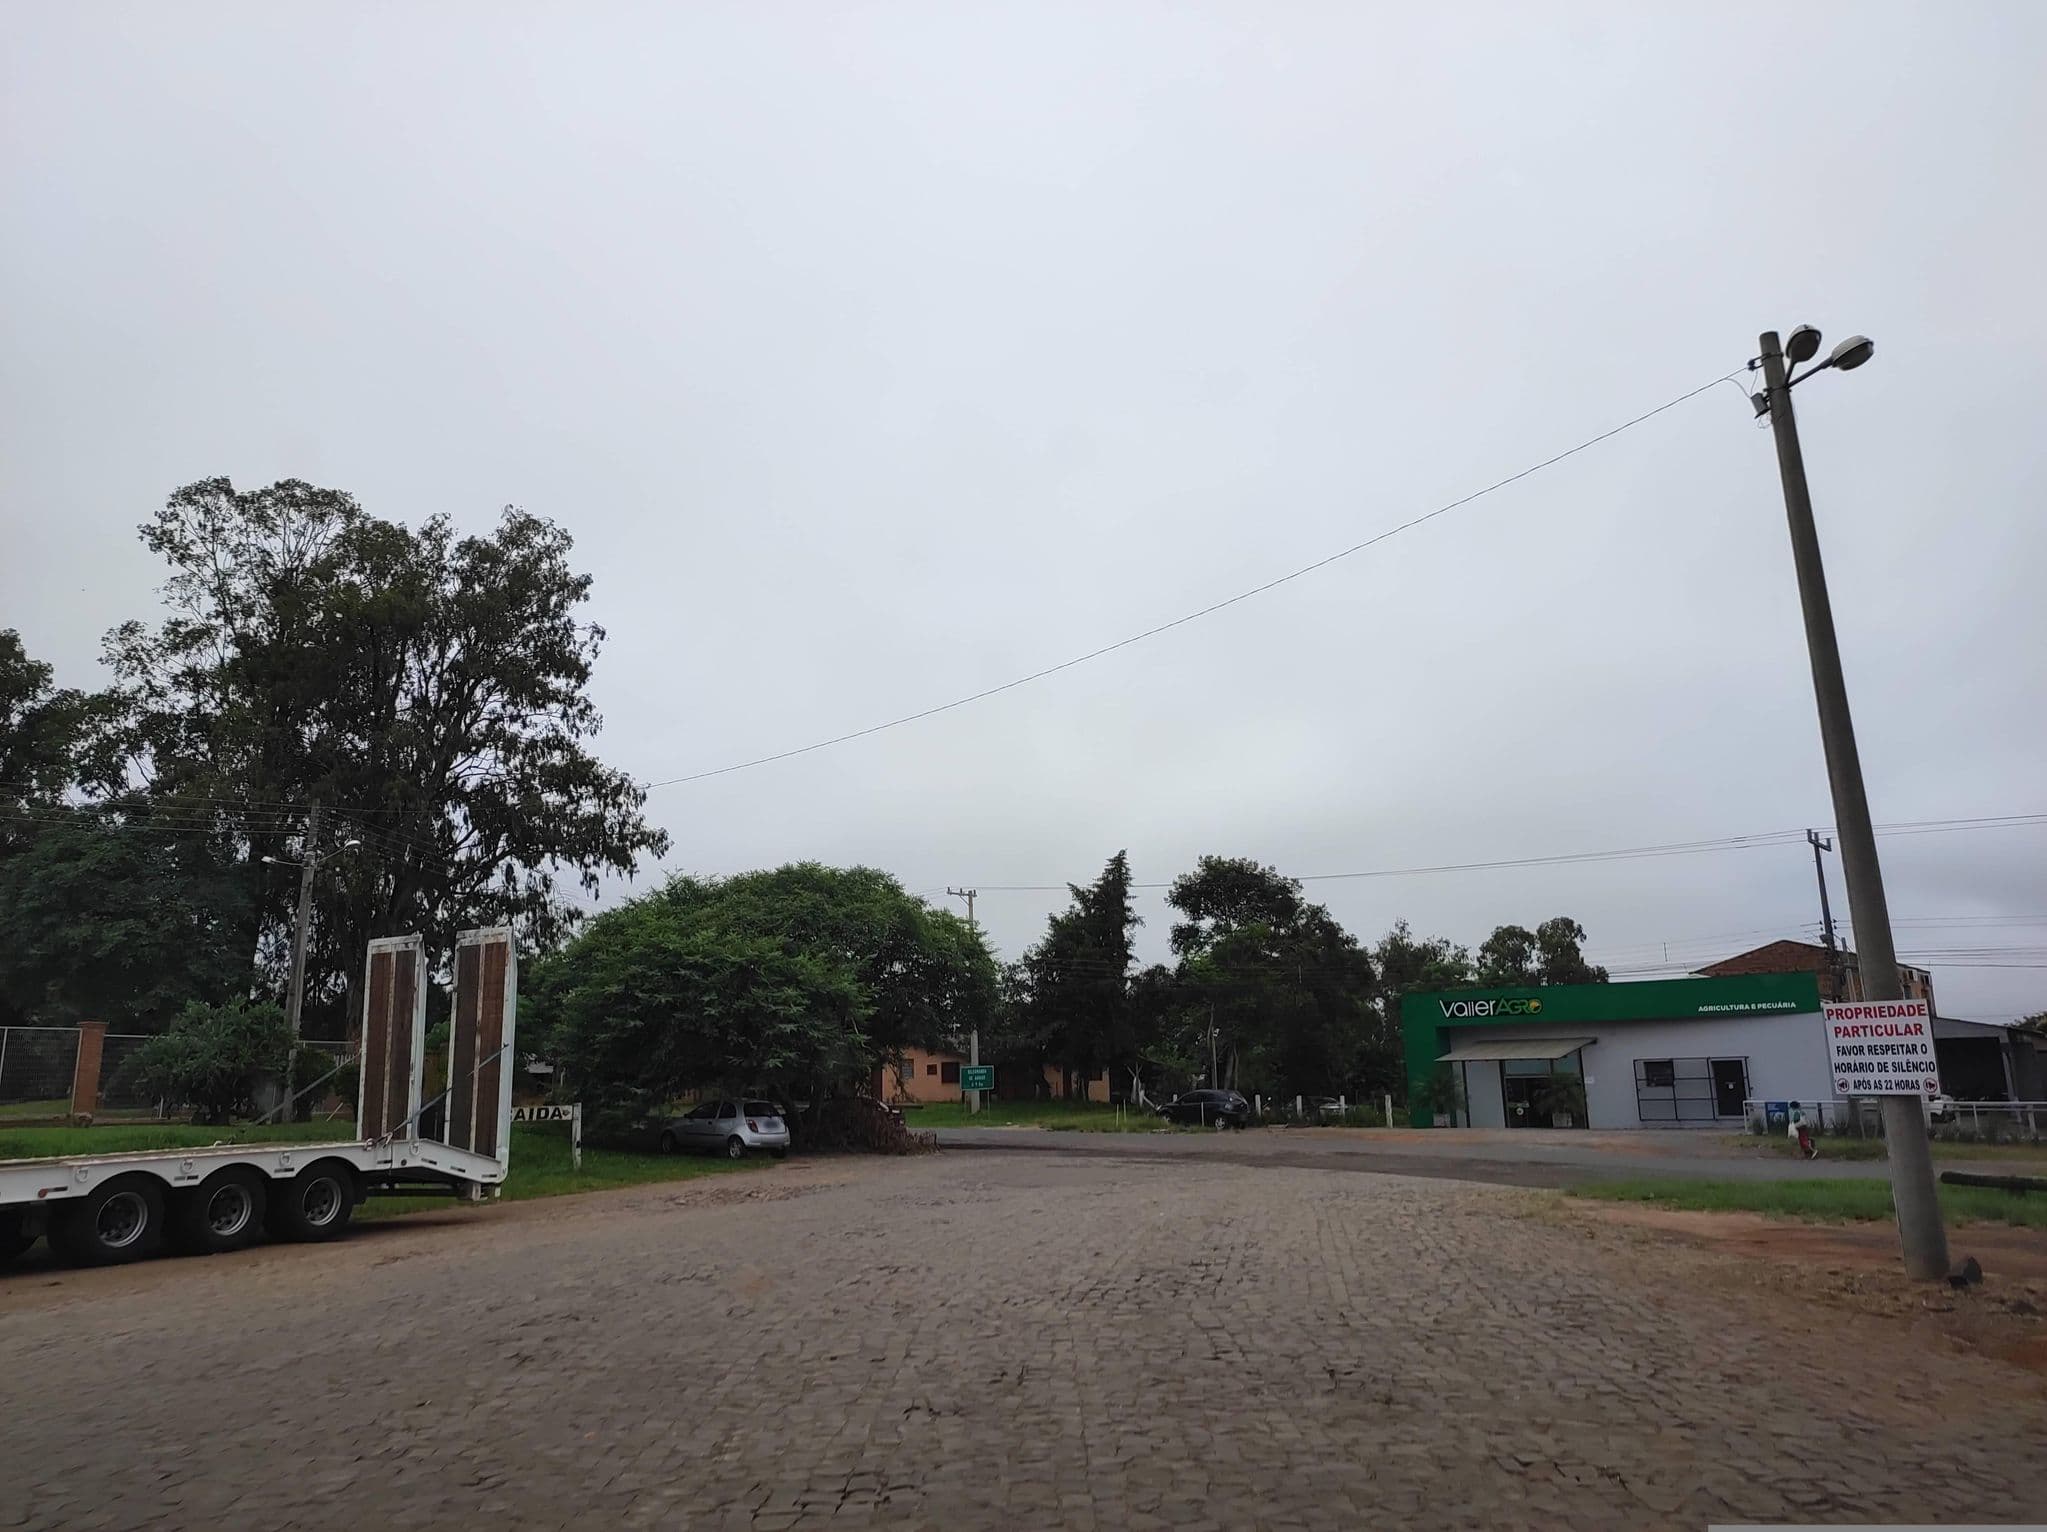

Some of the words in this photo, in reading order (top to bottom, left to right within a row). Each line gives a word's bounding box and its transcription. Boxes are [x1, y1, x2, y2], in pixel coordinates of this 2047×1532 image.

[1698, 1004, 1750, 1012] AGRICULTURA
[1757, 1001, 1797, 1010] PECUÁRIA
[1826, 1004, 1926, 1021] PROPRIEDADE
[1834, 1023, 1924, 1039] PARTICULAR
[1836, 1045, 1866, 1057] FAVOR
[1867, 1044, 1918, 1056] RESPEITAR
[1920, 1043, 1928, 1054] O
[1834, 1060, 1875, 1073] HORÁRIO
[1877, 1061, 1890, 1073] DE
[1892, 1059, 1936, 1073] SILÊNCIO
[1853, 1077, 1872, 1091] APÓS
[1884, 1079, 1893, 1091] 22
[1894, 1079, 1921, 1091] HORAS
[511, 1107, 562, 1121] AIDA
